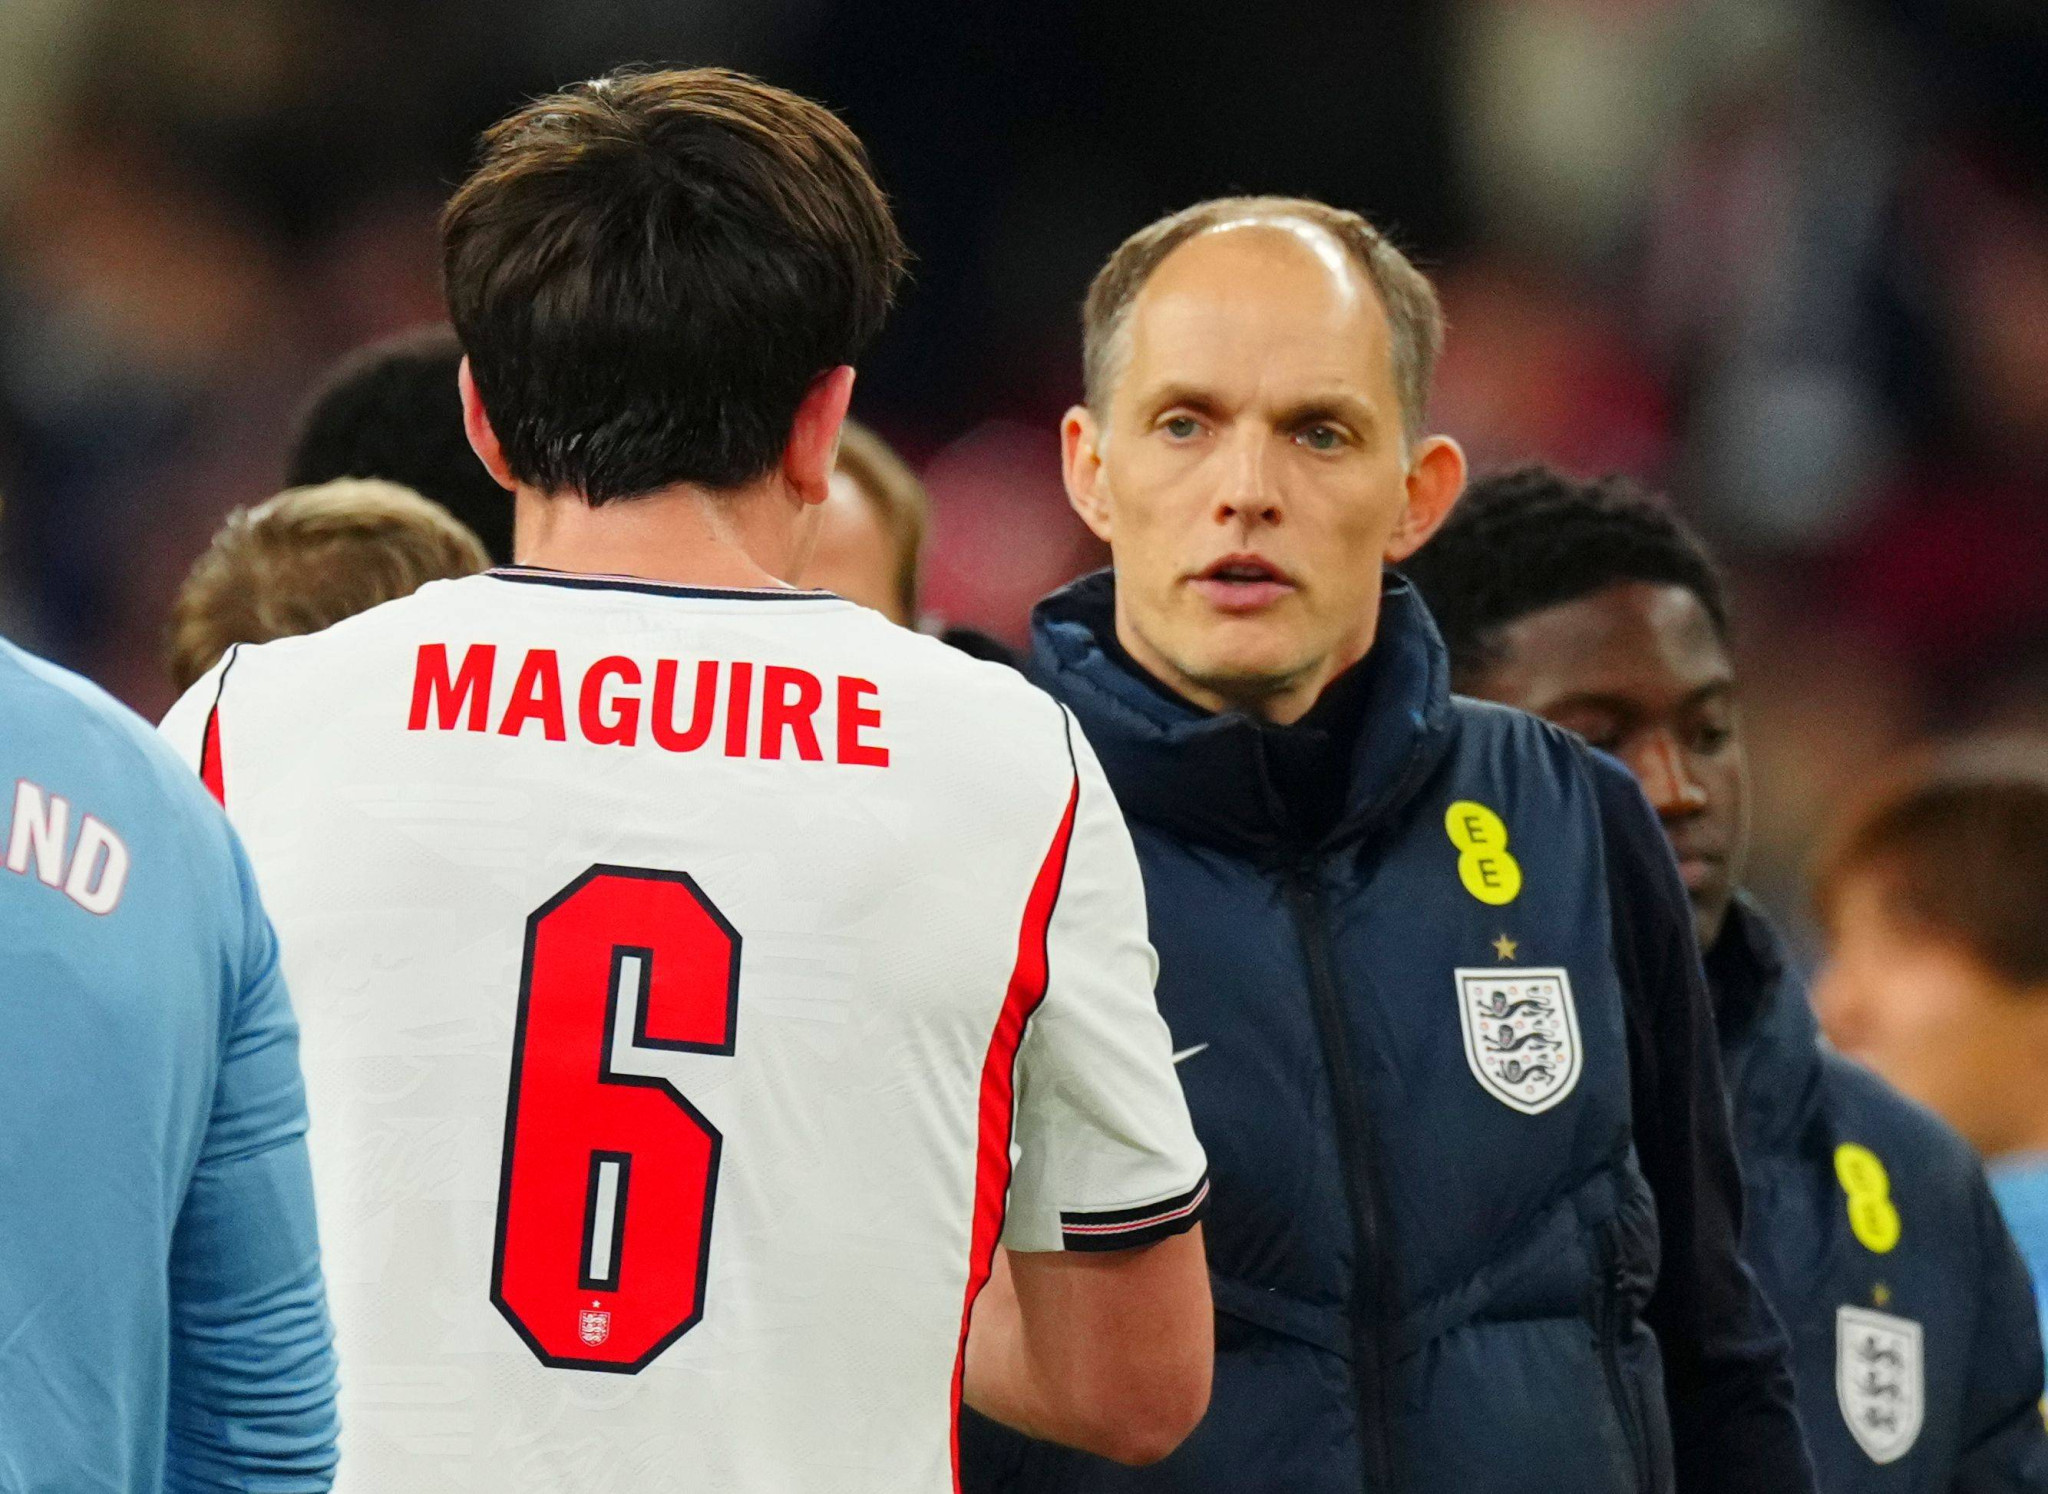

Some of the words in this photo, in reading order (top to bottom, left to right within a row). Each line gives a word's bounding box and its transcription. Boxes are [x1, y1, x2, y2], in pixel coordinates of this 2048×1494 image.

[407, 643, 889, 768] MAGUIRE
[0, 777, 130, 916] ND
[490, 863, 743, 1375] 6
